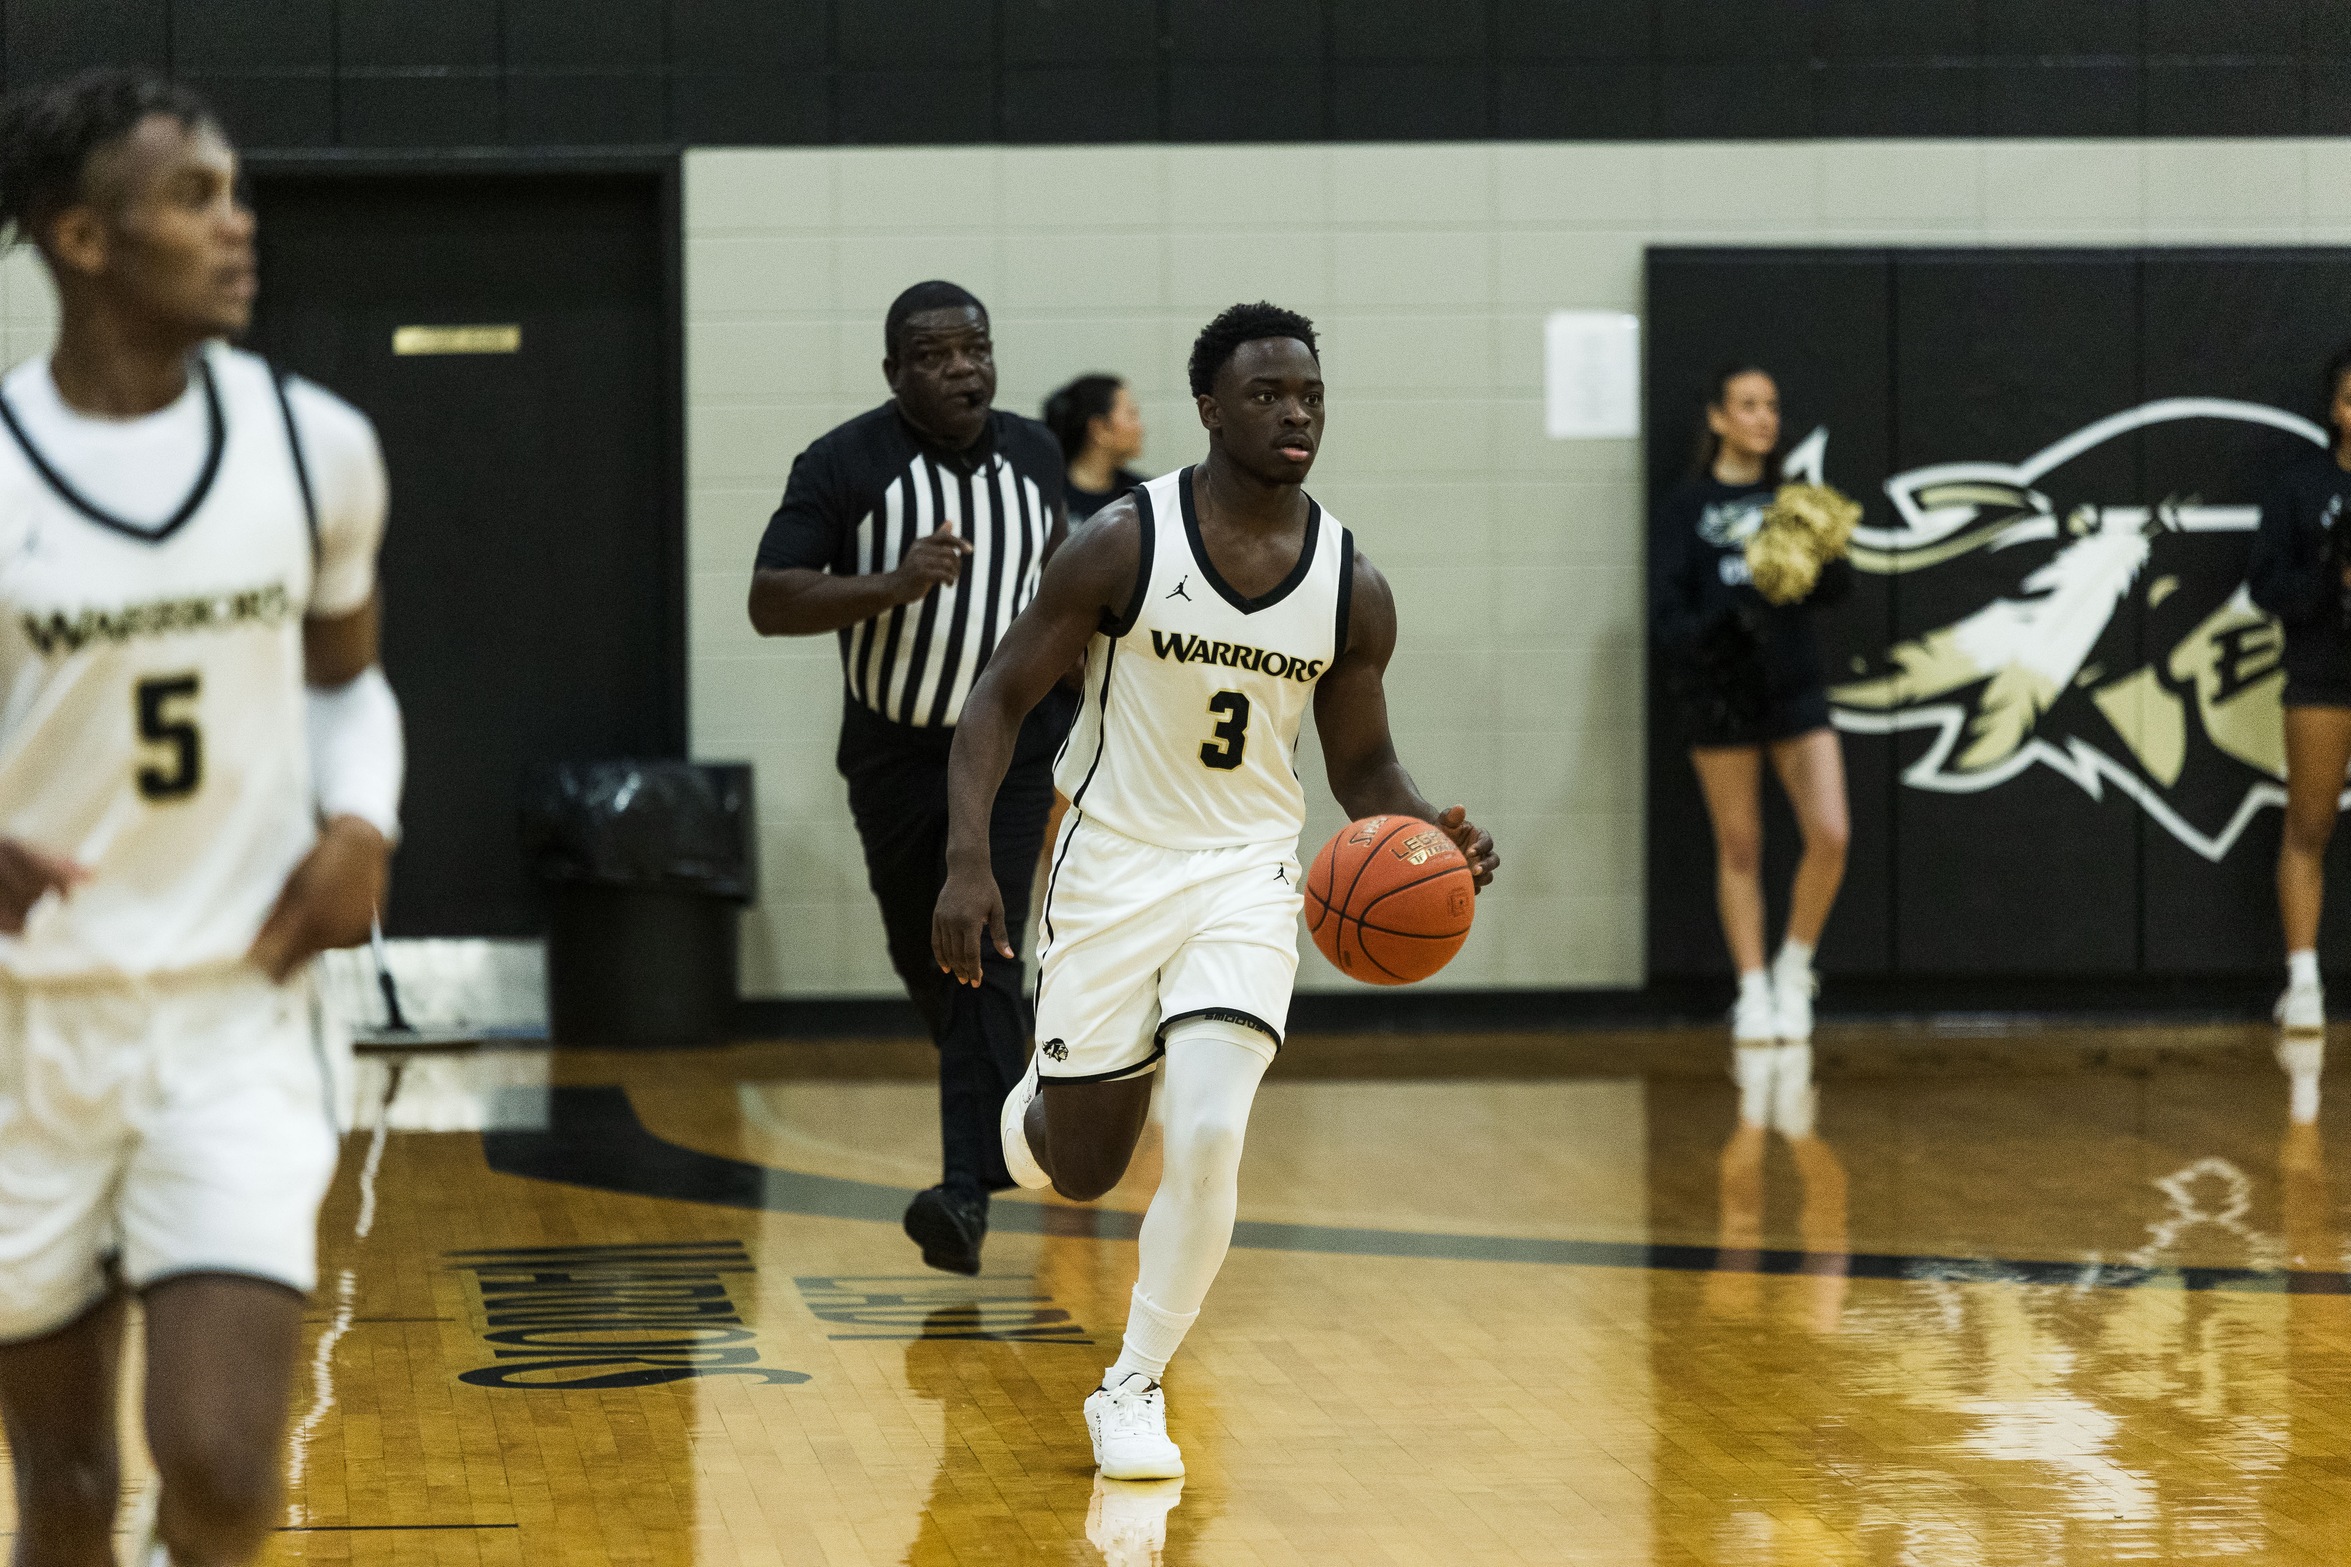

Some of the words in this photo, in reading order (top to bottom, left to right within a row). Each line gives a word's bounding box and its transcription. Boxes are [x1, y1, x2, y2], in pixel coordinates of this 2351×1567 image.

[1150, 629, 1323, 683] WARRIORS
[134, 671, 203, 798] 5
[1198, 688, 1252, 771] 3
[440, 1240, 812, 1389] WARRIORS
[792, 1275, 1095, 1345] LADY
